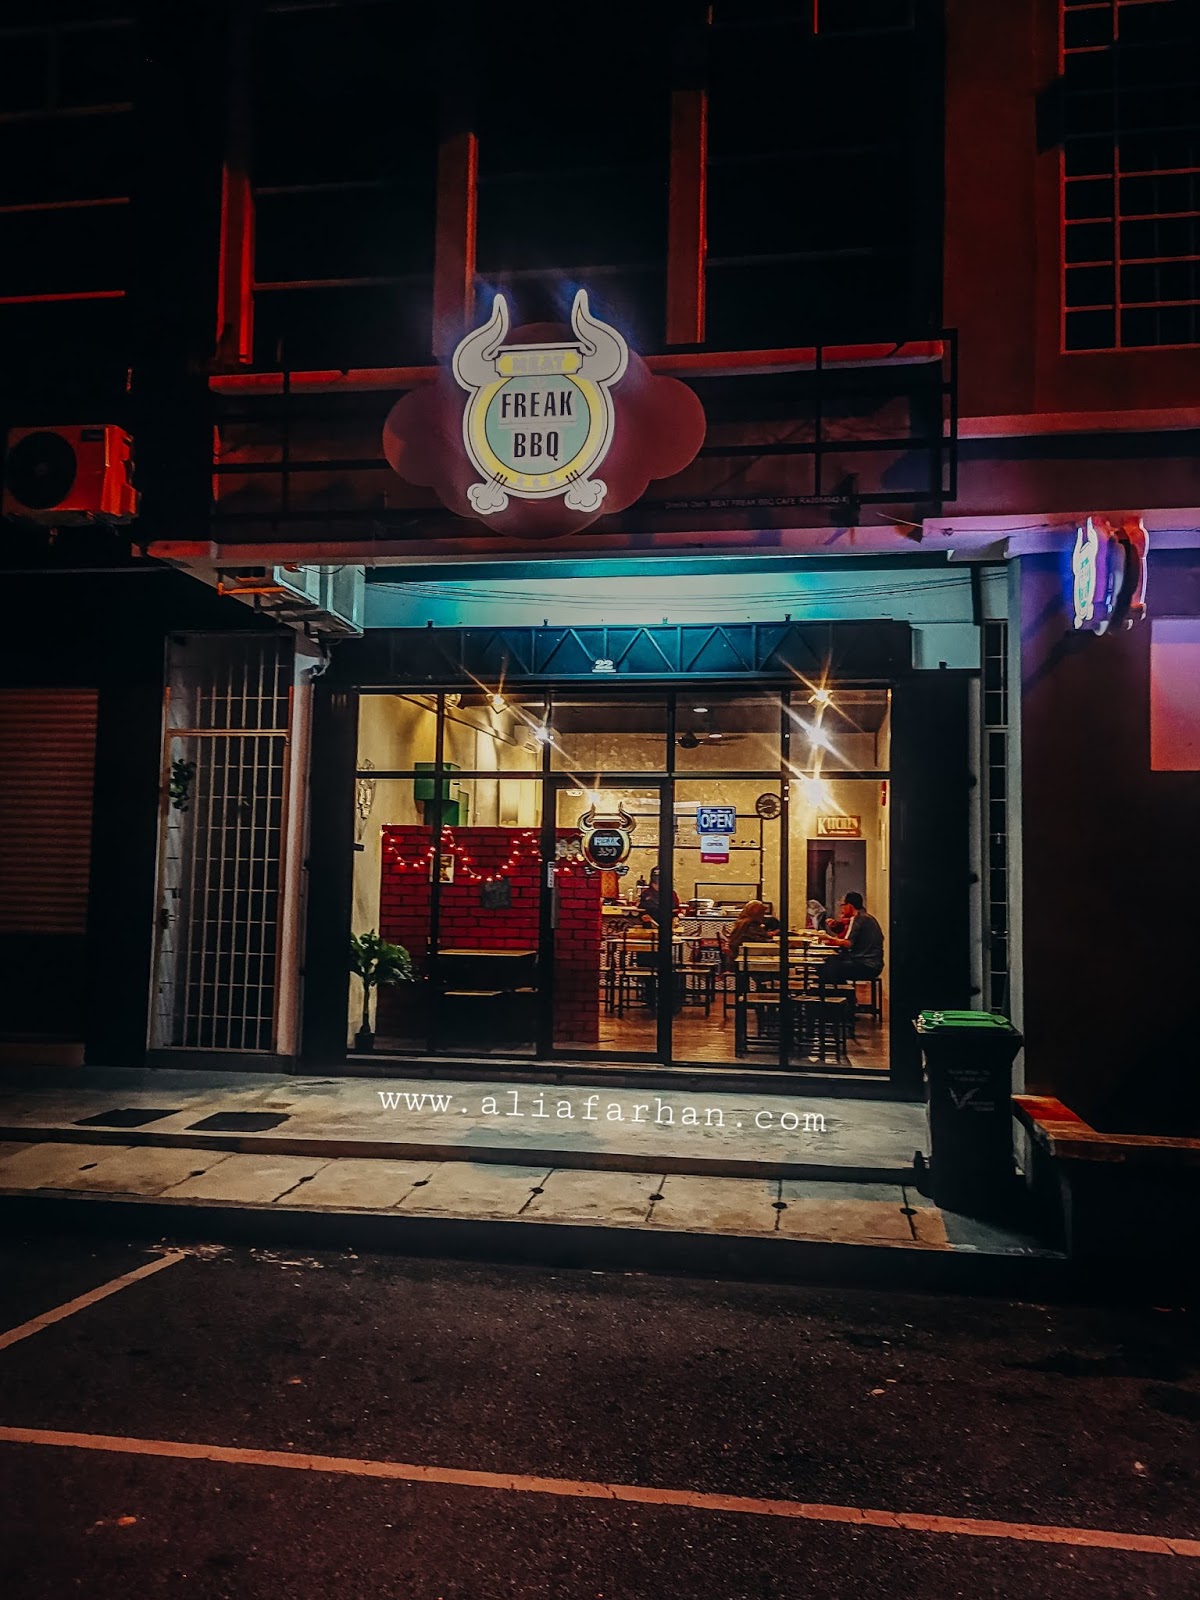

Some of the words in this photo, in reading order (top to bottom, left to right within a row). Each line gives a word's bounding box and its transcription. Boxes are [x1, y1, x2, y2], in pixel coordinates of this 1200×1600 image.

[501, 390, 573, 418] FREAK
[513, 431, 559, 461] BBQ
[776, 497, 796, 505] CAFE
[595, 659, 614, 670] 22
[701, 813, 734, 828] OPEN
